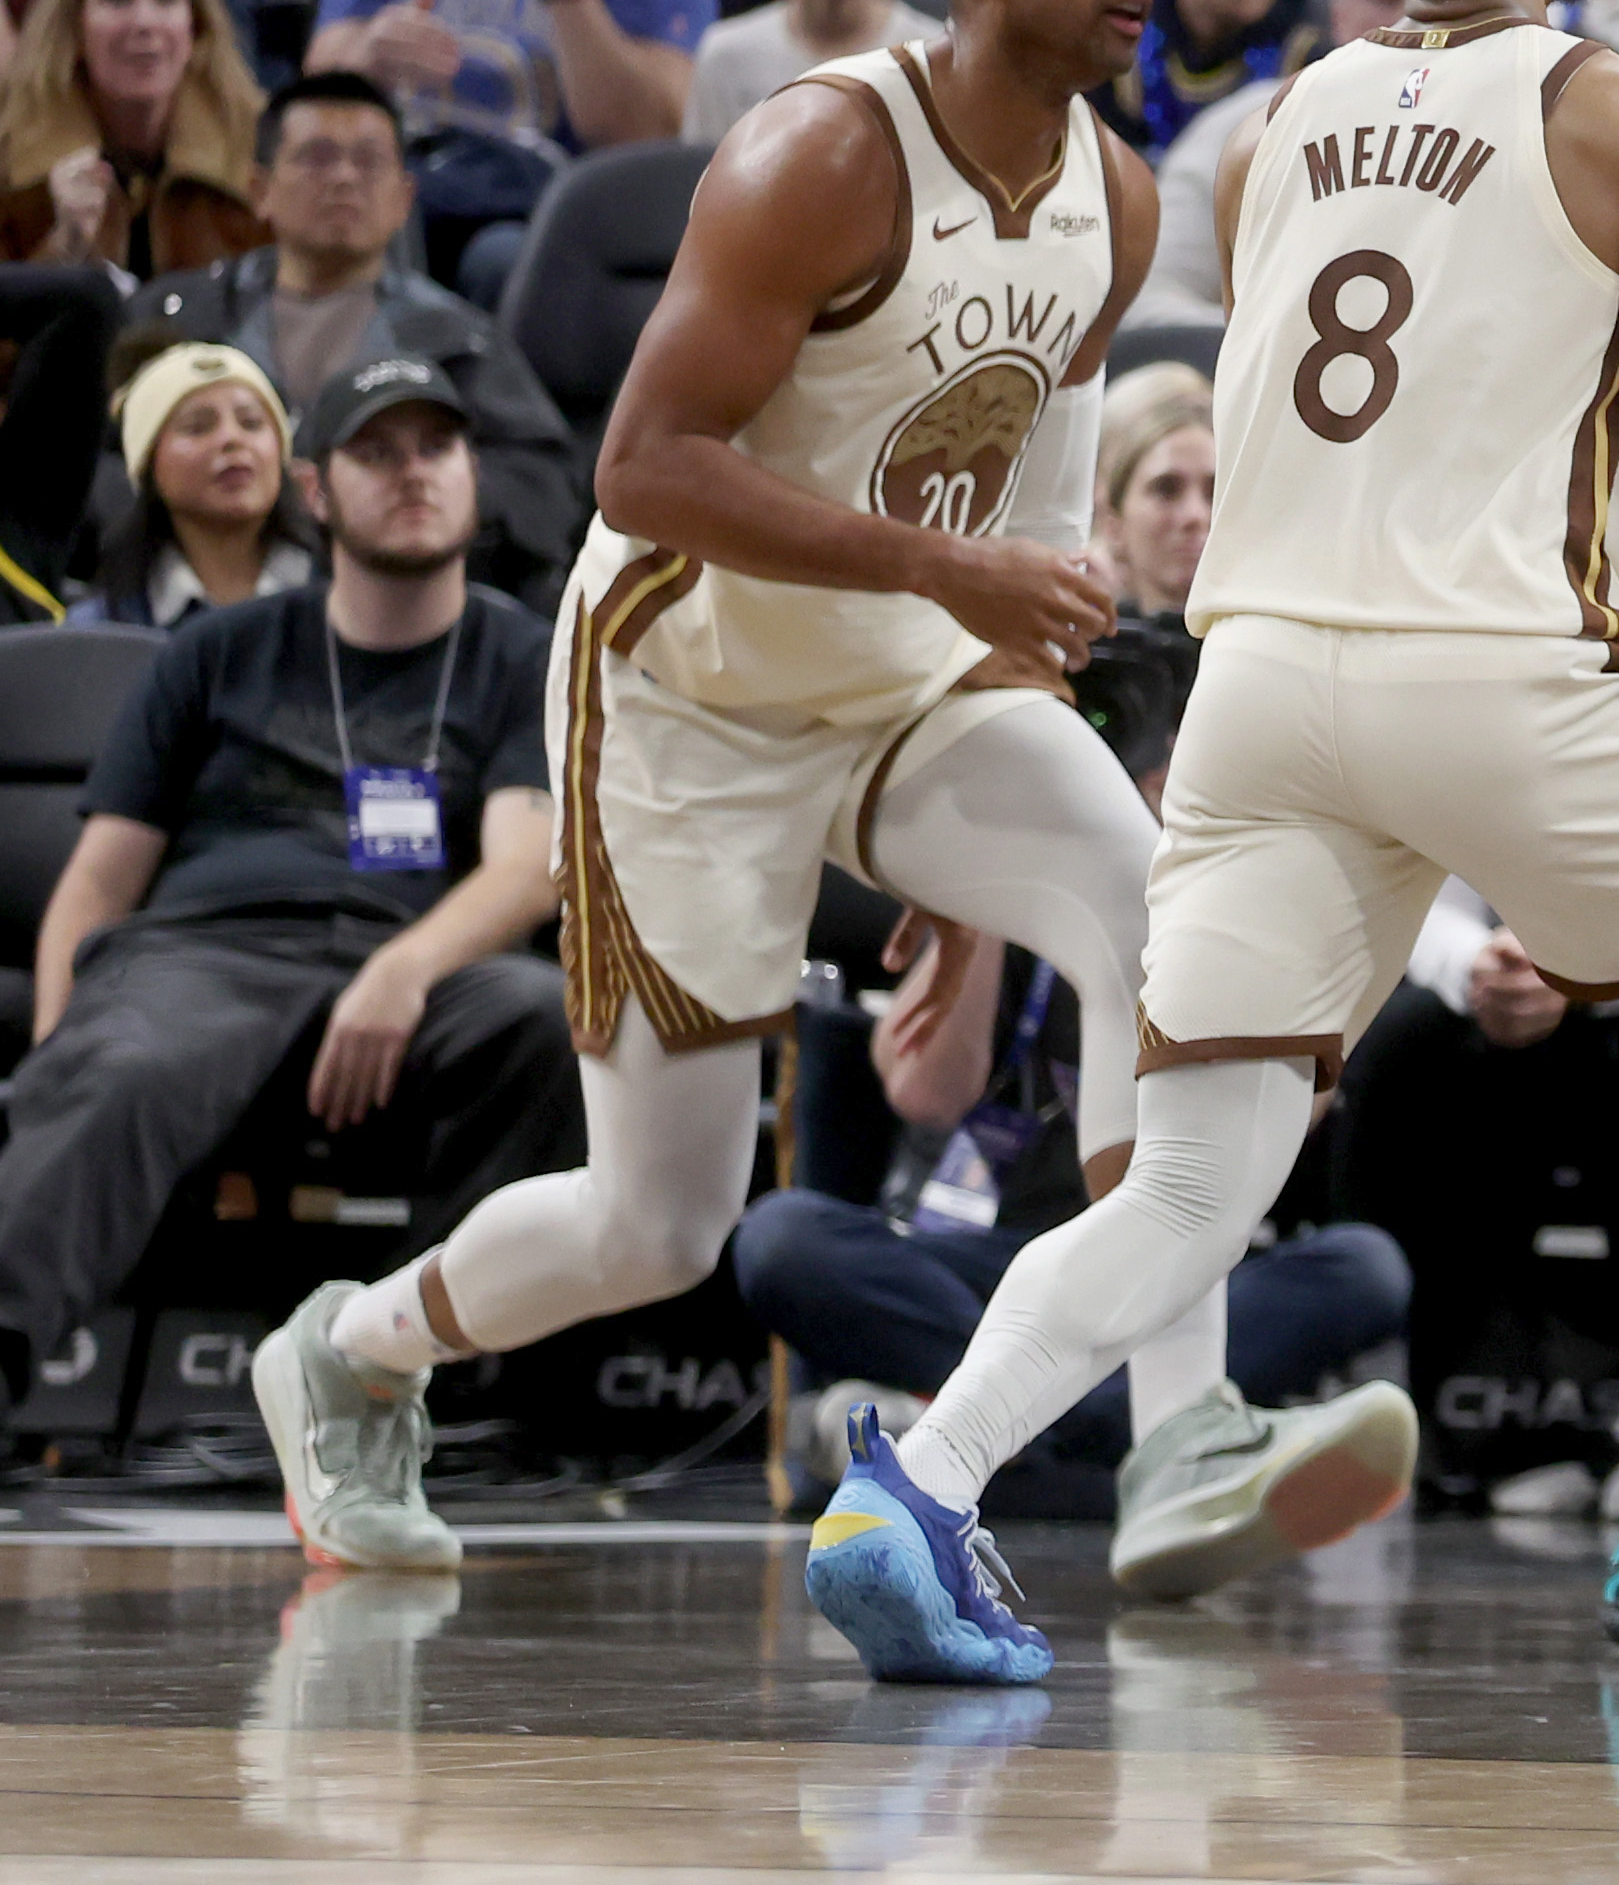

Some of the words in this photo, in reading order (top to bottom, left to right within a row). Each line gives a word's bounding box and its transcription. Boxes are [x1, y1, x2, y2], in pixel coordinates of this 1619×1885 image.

[1303, 123, 1497, 207] MELTON
[1050, 212, 1100, 234] Rakuten
[906, 282, 1084, 376] TOWN
[926, 279, 959, 321] The
[1293, 248, 1415, 444] 8
[920, 469, 977, 537] 20
[179, 1333, 253, 1386] CH
[598, 1354, 770, 1411] CHA
